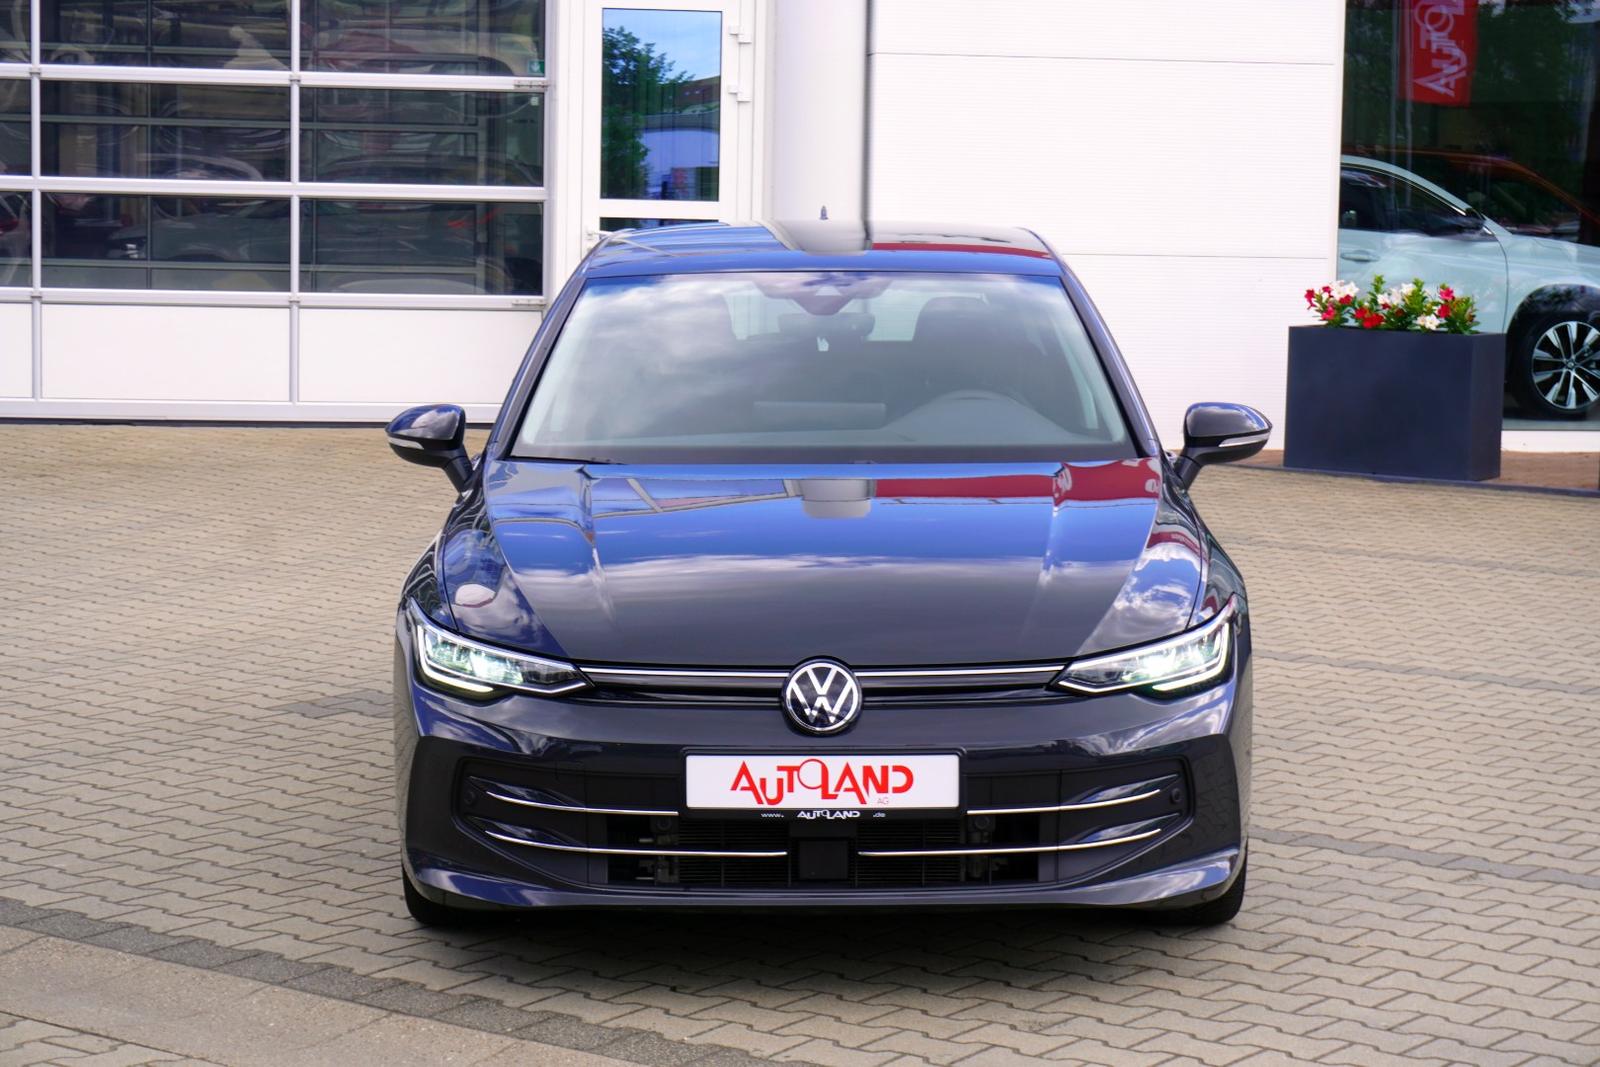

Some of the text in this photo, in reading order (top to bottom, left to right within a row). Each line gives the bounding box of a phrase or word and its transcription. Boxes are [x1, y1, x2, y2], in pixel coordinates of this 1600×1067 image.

[786, 663, 859, 731] VW
[730, 758, 914, 805] AUTOLAND
[796, 809, 861, 820] AUTOLAND
[876, 797, 890, 805] AG
